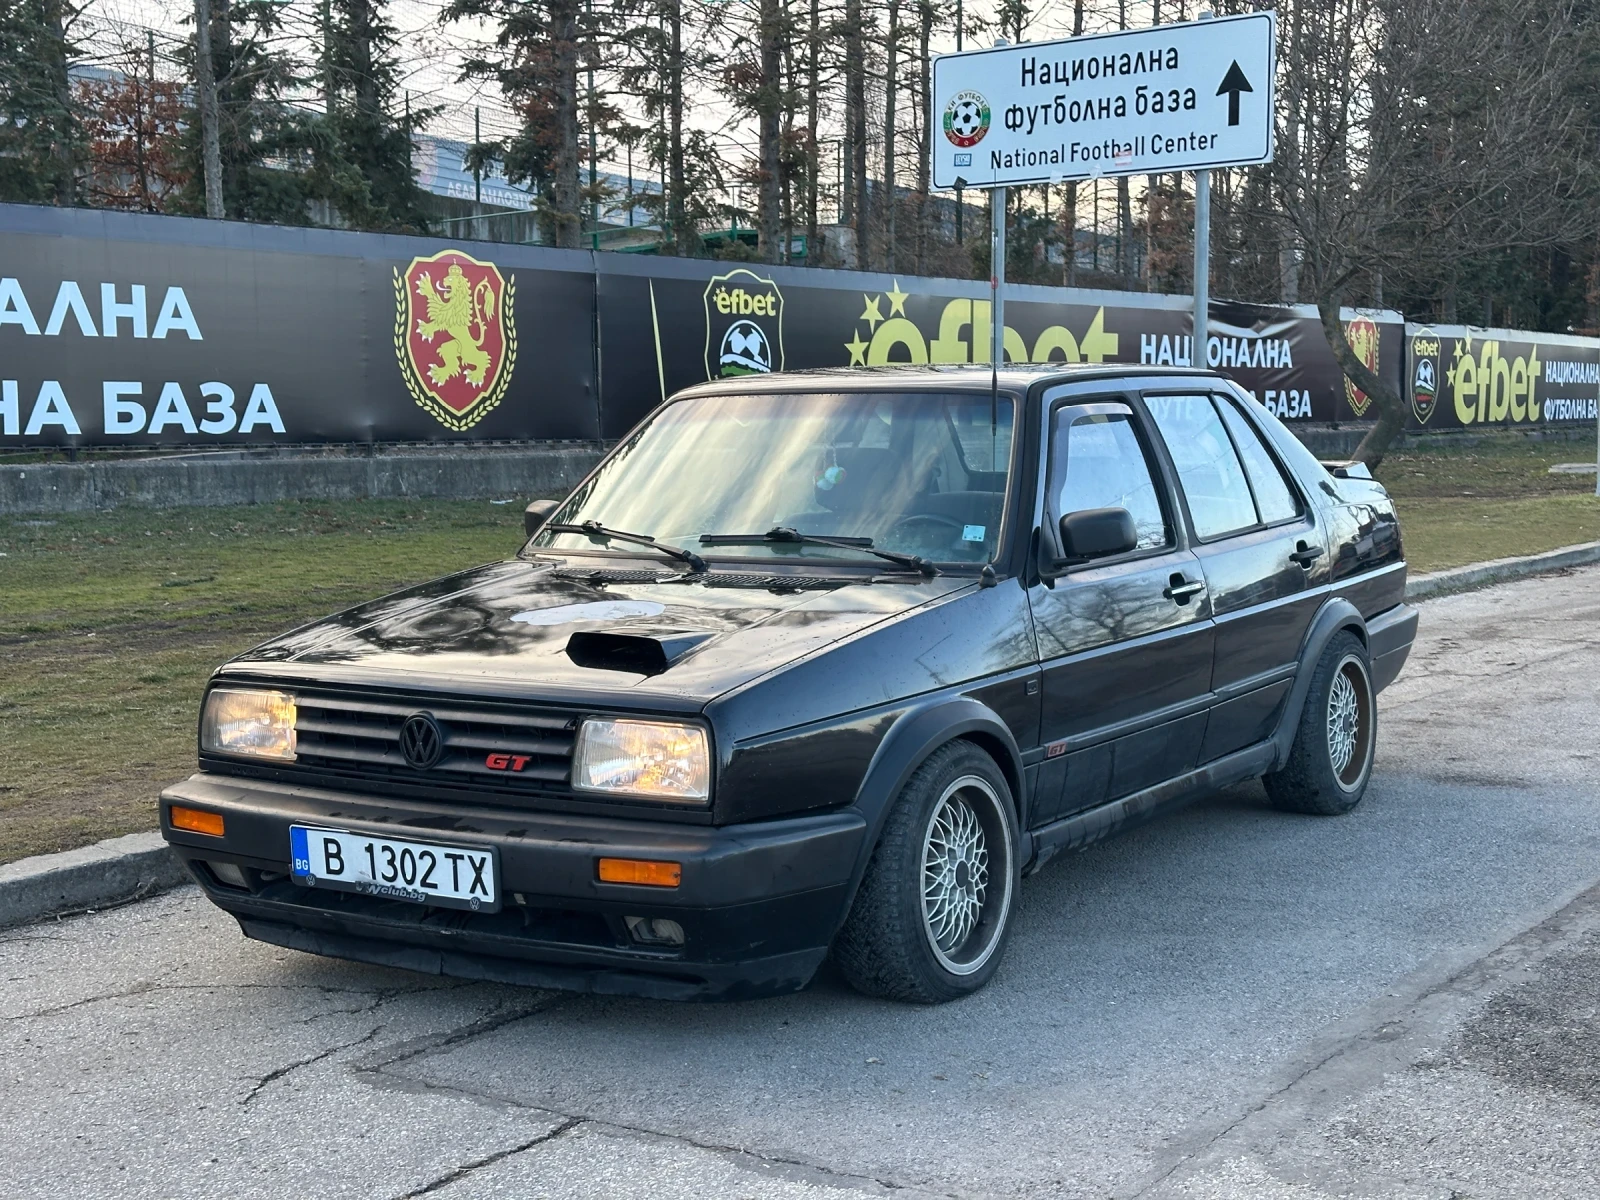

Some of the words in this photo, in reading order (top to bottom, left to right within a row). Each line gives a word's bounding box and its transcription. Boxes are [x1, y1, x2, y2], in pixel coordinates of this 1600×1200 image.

[1021, 47, 1179, 87] Национална
[1004, 94, 1126, 135] футболна
[1135, 85, 1196, 115] база
[991, 143, 1065, 170] National
[1071, 137, 1145, 162] Football
[1151, 132, 1218, 154] Center
[715, 288, 776, 316] efbet
[1141, 334, 1292, 368] НАЦОНАЛНА
[1415, 340, 1439, 356] efbet
[1454, 341, 1541, 424] efbet
[103, 381, 286, 434] БАЗА
[1264, 389, 1312, 418] БАЗА
[1544, 397, 1587, 421] ФУТБОЛНА
[1588, 398, 1599, 418] БА
[485, 753, 532, 772] GT
[1049, 742, 1066, 756] GT
[295, 858, 309, 871] BG
[323, 837, 345, 876] B
[364, 842, 438, 890] 1302
[444, 852, 489, 896] TX
